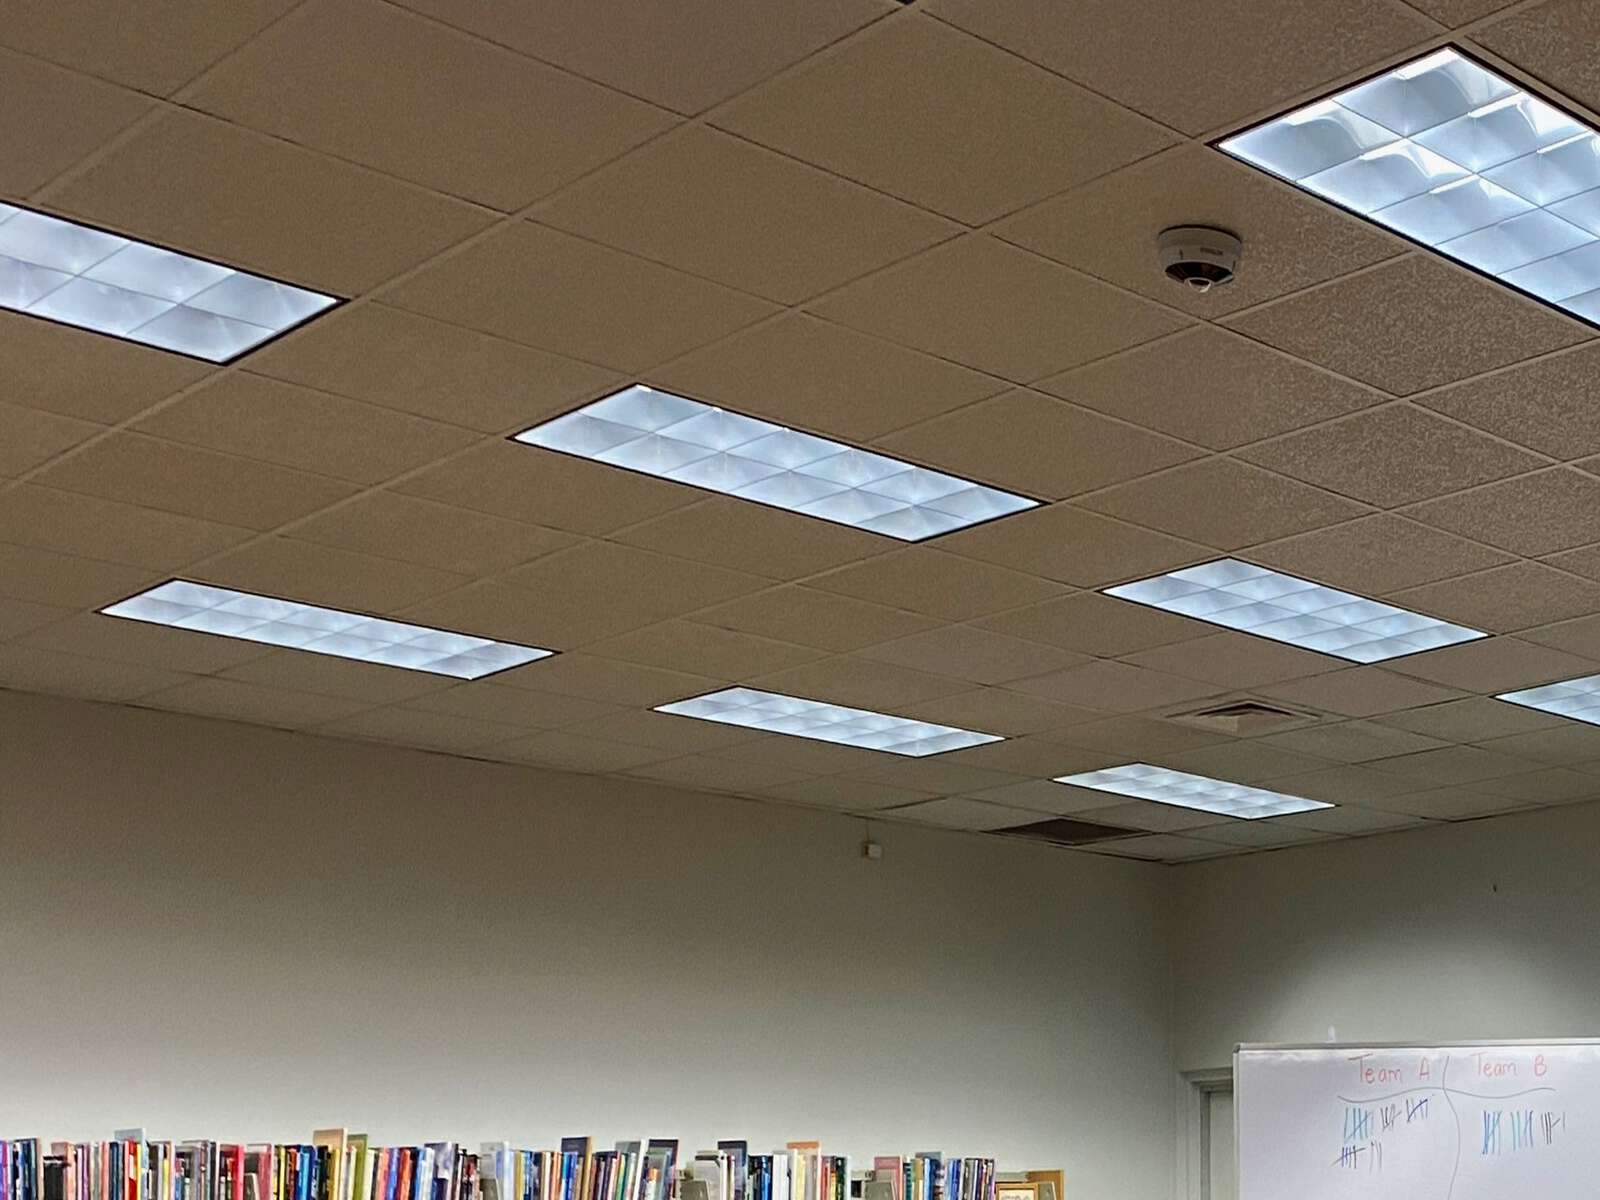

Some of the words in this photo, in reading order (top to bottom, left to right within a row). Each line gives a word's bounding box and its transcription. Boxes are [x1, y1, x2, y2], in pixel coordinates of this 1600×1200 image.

[1348, 1053, 1401, 1084] Team
[1419, 1057, 1432, 1080] A
[1470, 1052, 1517, 1078] Team
[1534, 1055, 1548, 1076] B
